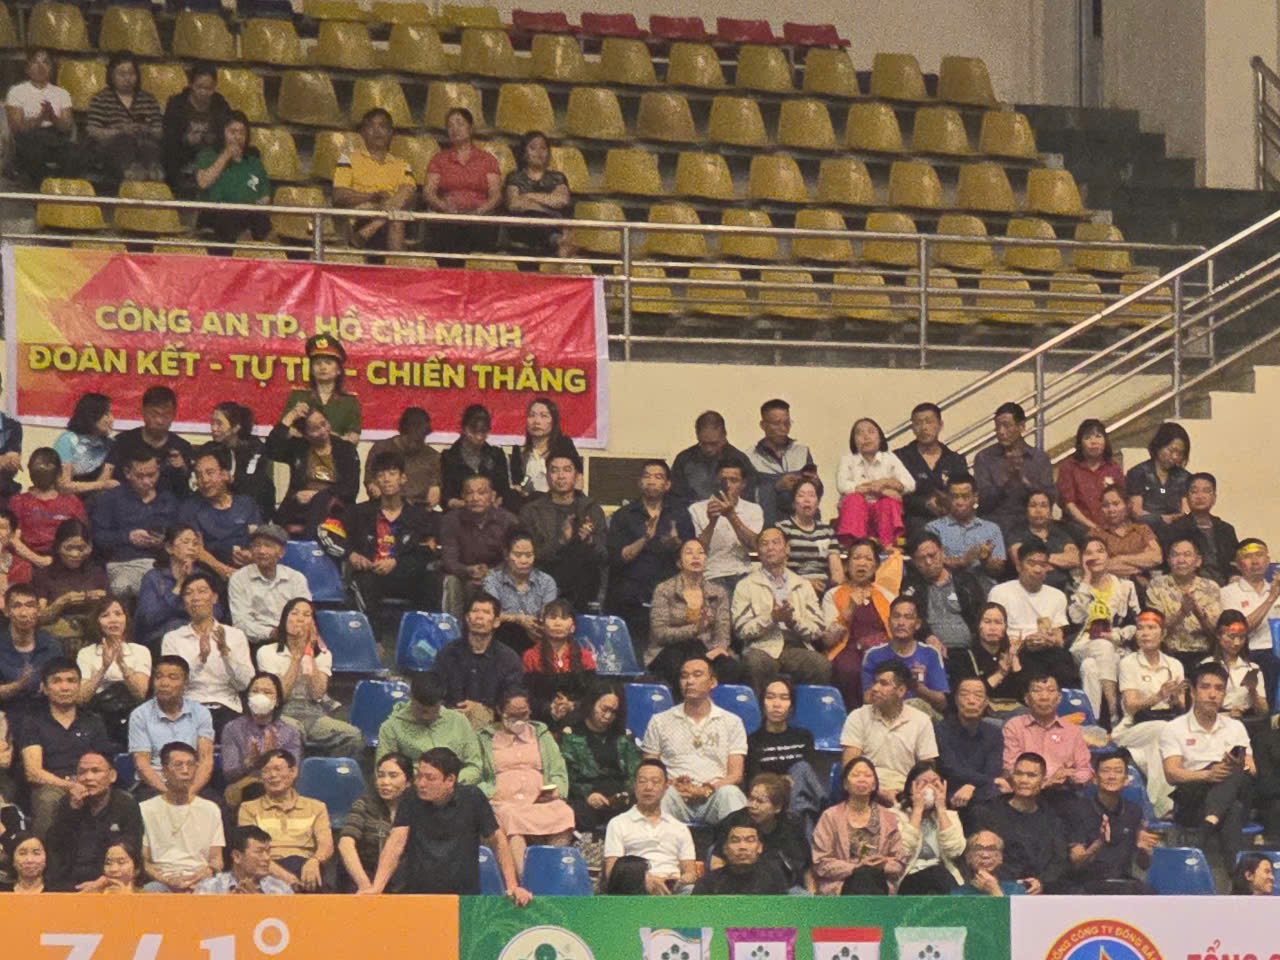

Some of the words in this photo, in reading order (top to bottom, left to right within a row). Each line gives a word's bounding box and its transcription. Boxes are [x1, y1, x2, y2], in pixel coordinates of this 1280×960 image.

[95, 303, 192, 333] CÔNG
[201, 315, 249, 338] AN
[259, 314, 306, 340] TP.
[315, 306, 363, 342] HỒ
[435, 323, 523, 347] MINH
[28, 344, 128, 374] ĐOÀN
[137, 341, 201, 376] KẾT
[235, 355, 278, 387] TỰ
[279, 358, 312, 382] TI
[366, 352, 465, 387] CHIẾN
[472, 352, 588, 393] THẮNG
